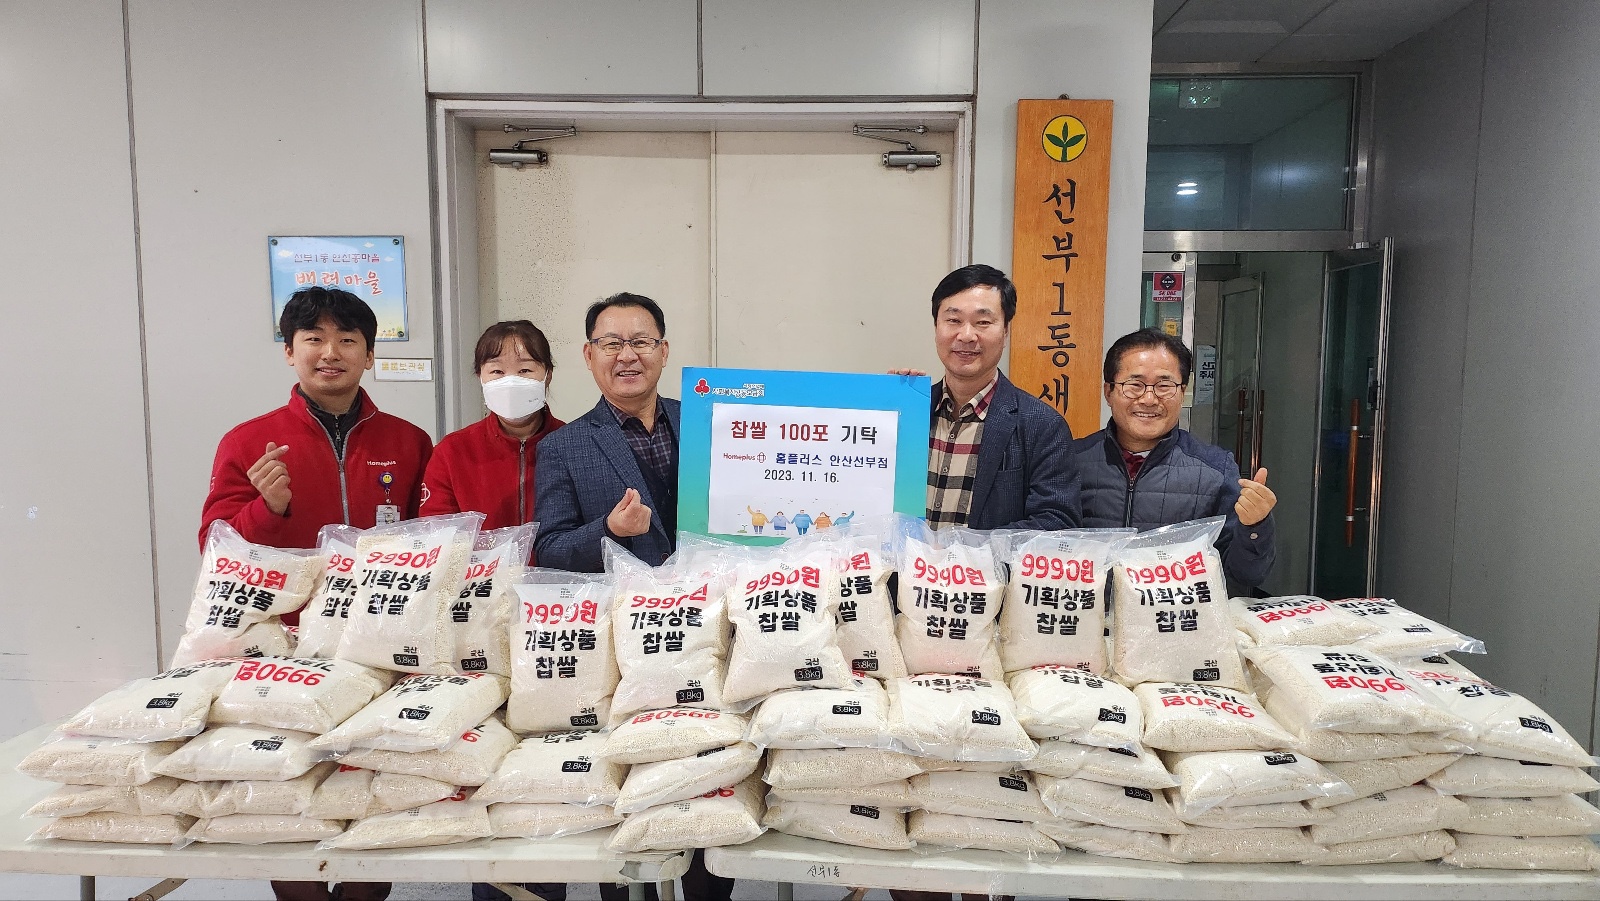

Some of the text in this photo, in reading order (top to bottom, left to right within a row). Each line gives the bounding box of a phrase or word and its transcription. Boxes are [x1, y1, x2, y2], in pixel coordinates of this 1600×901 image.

[731, 420, 877, 444] 찹쌀 100포 기탁
[723, 452, 756, 462] Homeplus
[776, 452, 888, 468] 홈플러스 안산선부점
[764, 469, 839, 483] 2023. 11. 16.
[366, 545, 442, 568] 9990원
[1126, 551, 1206, 584] 9990원
[210, 557, 288, 590] 9990원
[913, 557, 986, 587] 9990원
[1021, 554, 1095, 583] 9990원
[361, 569, 432, 592] 기획상품
[745, 566, 820, 595] 9990원
[207, 580, 275, 612] 기획상품
[368, 593, 409, 615] 찹쌀
[745, 589, 817, 613] 기획상품
[913, 586, 987, 614] 기획상품
[1022, 584, 1096, 611] 기획상품
[1135, 581, 1211, 606] 기획상품
[206, 604, 245, 628] 찹쌀
[630, 607, 703, 630] 기획상품
[758, 612, 801, 633] 찹쌀
[927, 615, 968, 640] 찹쌀
[1037, 613, 1079, 635] 찹쌀
[1156, 609, 1198, 632] 찹쌀
[525, 629, 596, 651] 기획상품
[643, 631, 685, 654] 찹쌀
[395, 655, 417, 666] 3.8kg
[463, 660, 486, 670] 3.8kg
[536, 656, 578, 679] 찹쌀
[805, 658, 819, 666] 국산
[853, 661, 877, 670] 3.8kg
[232, 660, 326, 686] 9990원
[797, 669, 821, 680] 3.8kg
[1195, 670, 1218, 680] 3.8kg
[150, 699, 175, 708] 3.8kg
[679, 690, 702, 701] 3.8kg
[573, 716, 597, 725] 3.8kg
[835, 706, 860, 715] 3.8kg
[973, 713, 999, 724] 3.8kg
[564, 763, 589, 771] 3.8kg
